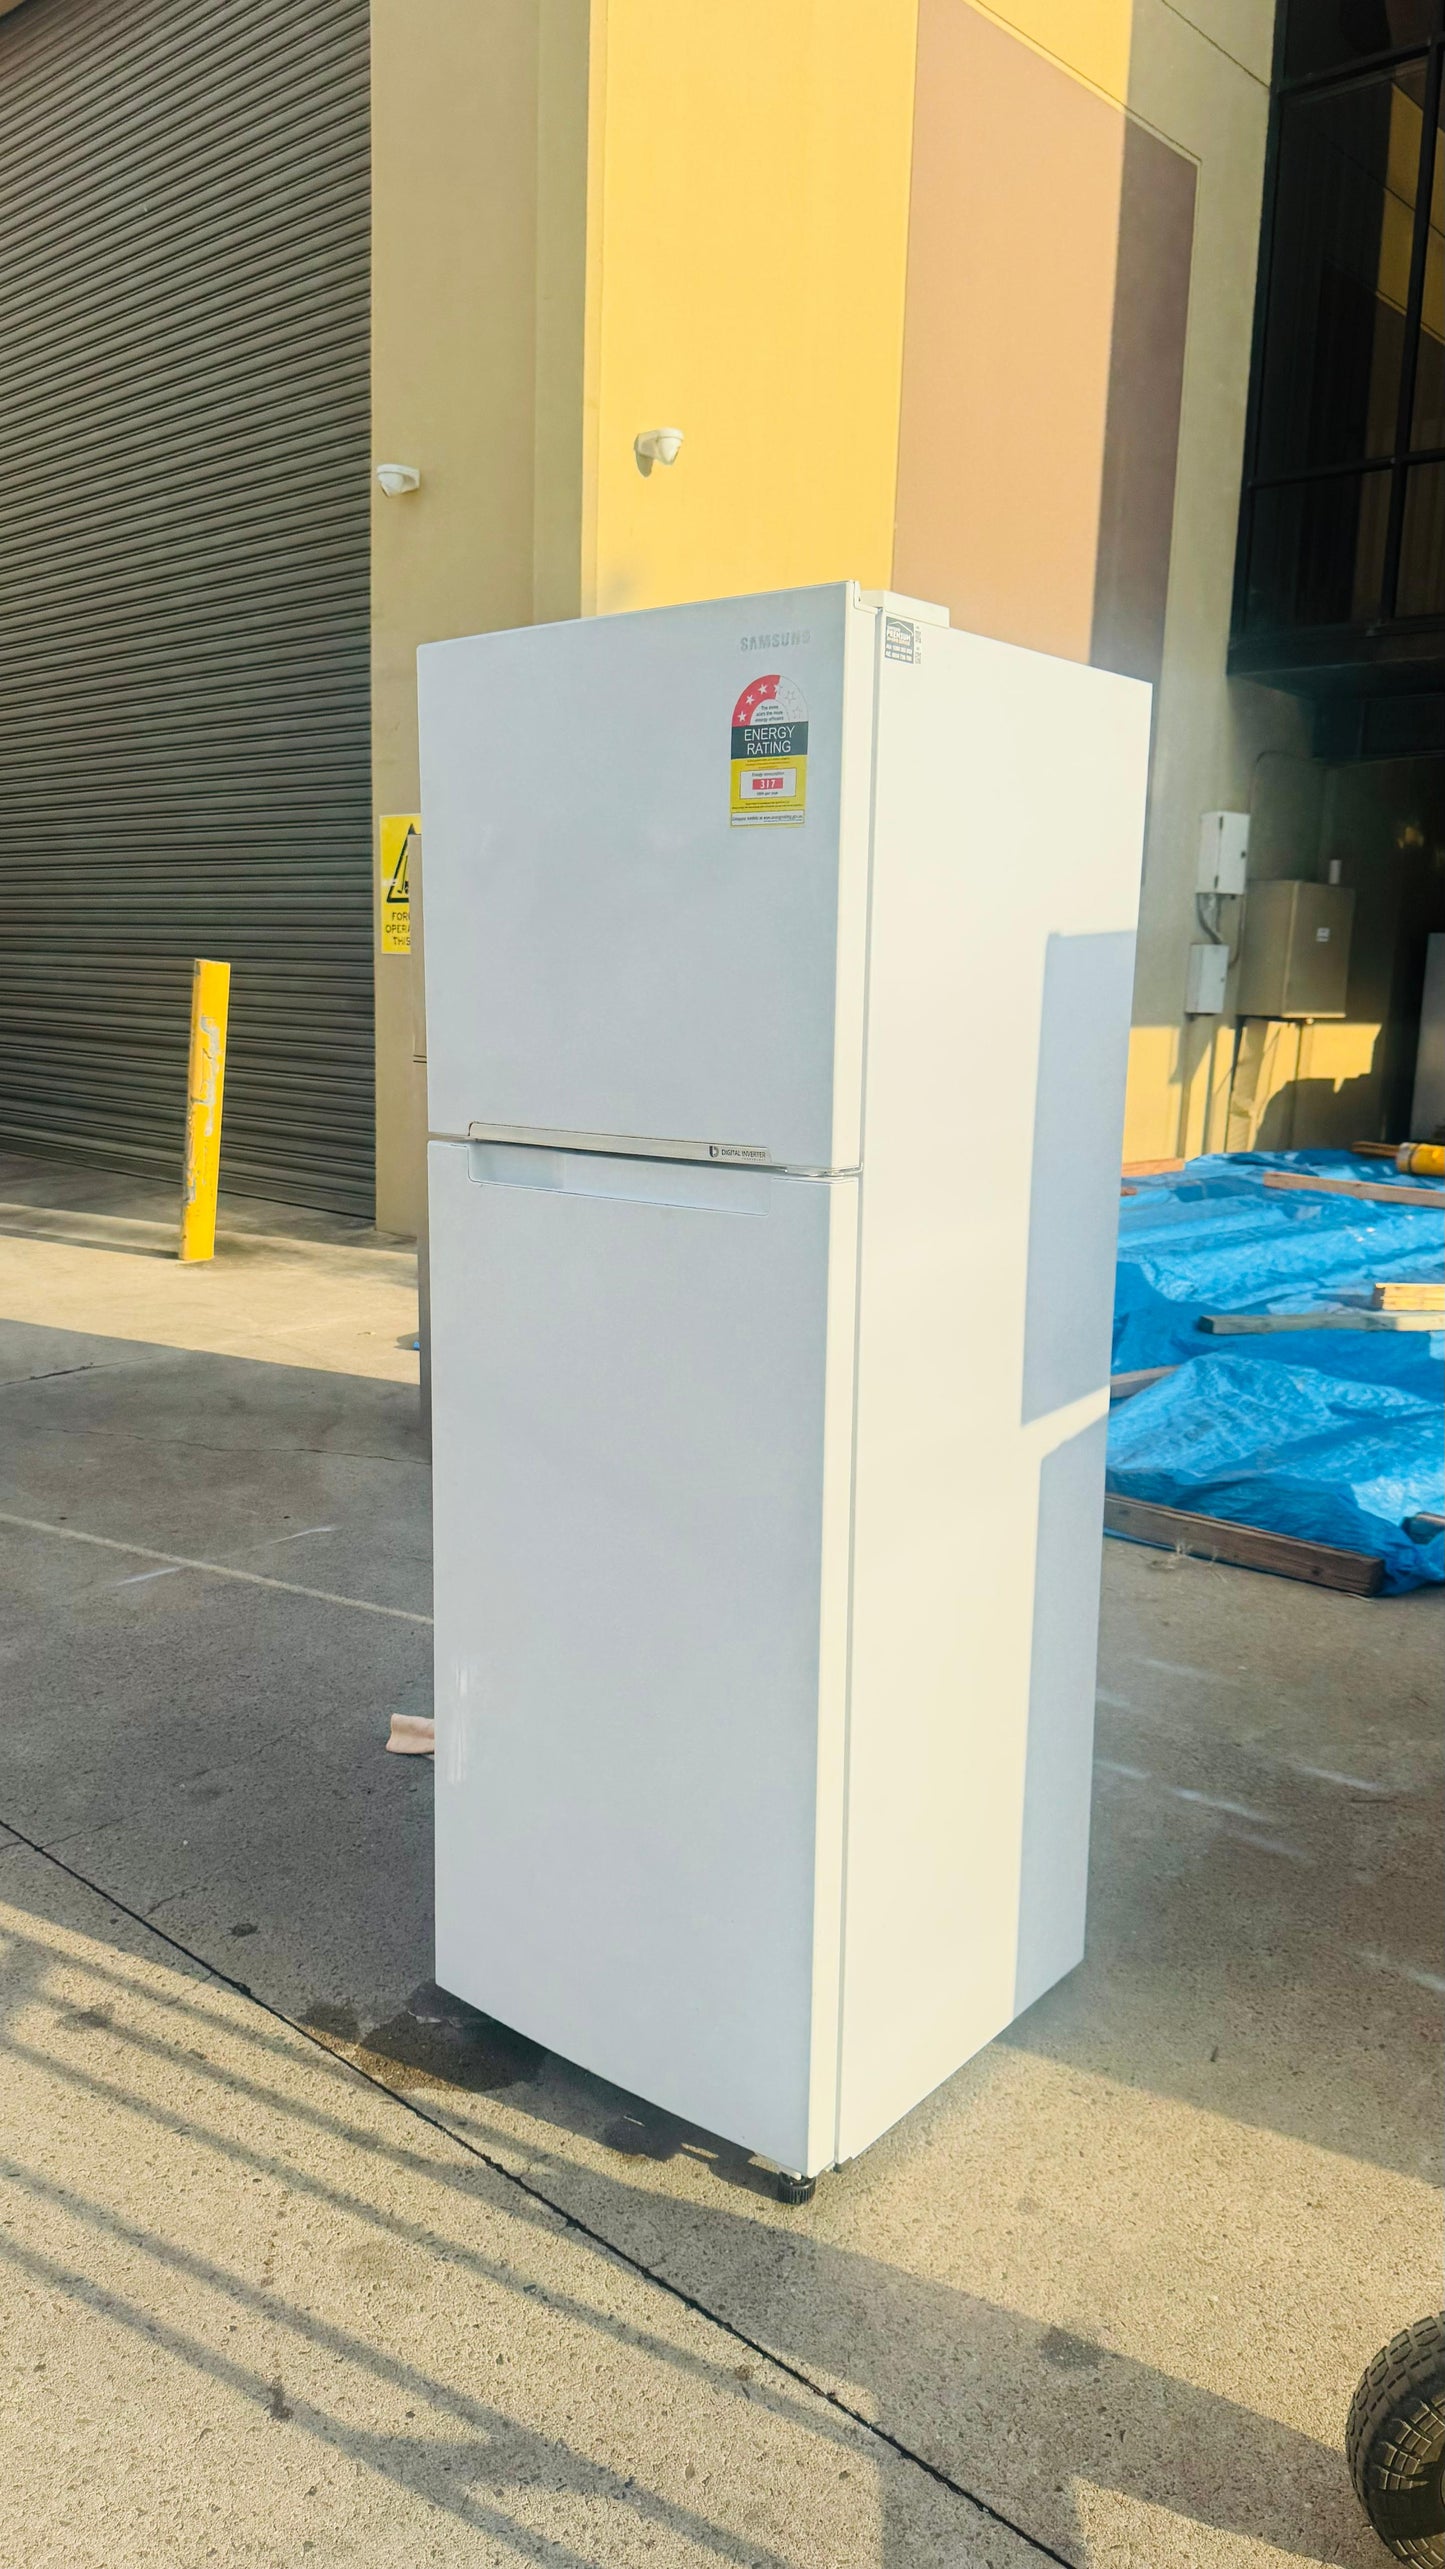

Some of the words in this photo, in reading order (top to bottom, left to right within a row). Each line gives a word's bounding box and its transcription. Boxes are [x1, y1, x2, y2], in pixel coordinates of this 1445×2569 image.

[740, 629, 811, 651] SAMSUNG
[744, 725, 796, 742] ENERGY
[747, 740, 791, 755] RATING
[760, 780, 776, 789] 317
[392, 911, 410, 921] FOR
[721, 1149, 741, 1157] DIGITAL
[741, 1150, 766, 1158] INVERTER
